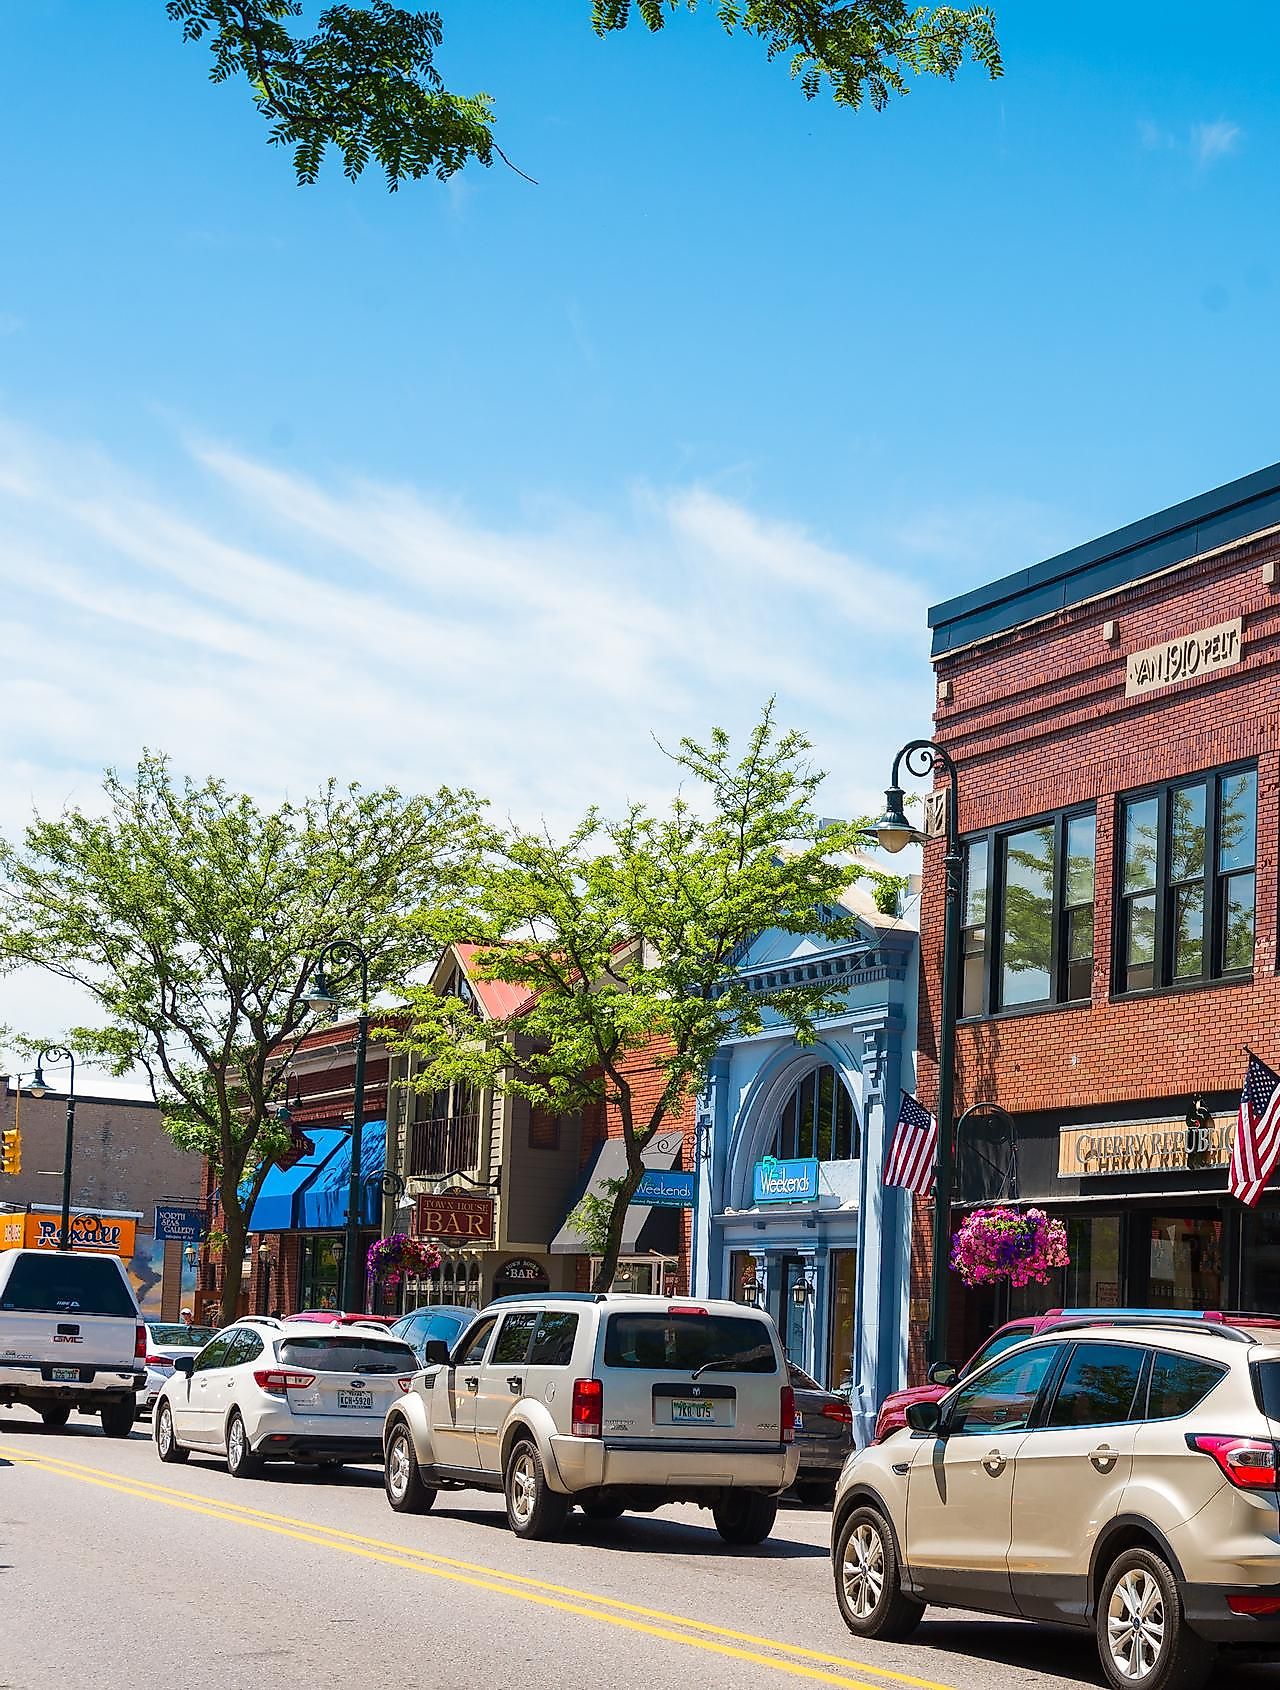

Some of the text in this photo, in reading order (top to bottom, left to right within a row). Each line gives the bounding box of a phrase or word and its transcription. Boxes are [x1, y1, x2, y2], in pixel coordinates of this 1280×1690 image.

[1164, 640, 1201, 682] 1910
[1076, 1131, 1146, 1164] CHERRY
[761, 1164, 810, 1194] Weekends
[424, 1199, 489, 1212] TOWN HOUSE
[424, 1211, 488, 1236] BAR
[510, 1269, 534, 1279] BAR
[53, 1335, 84, 1343] GMC
